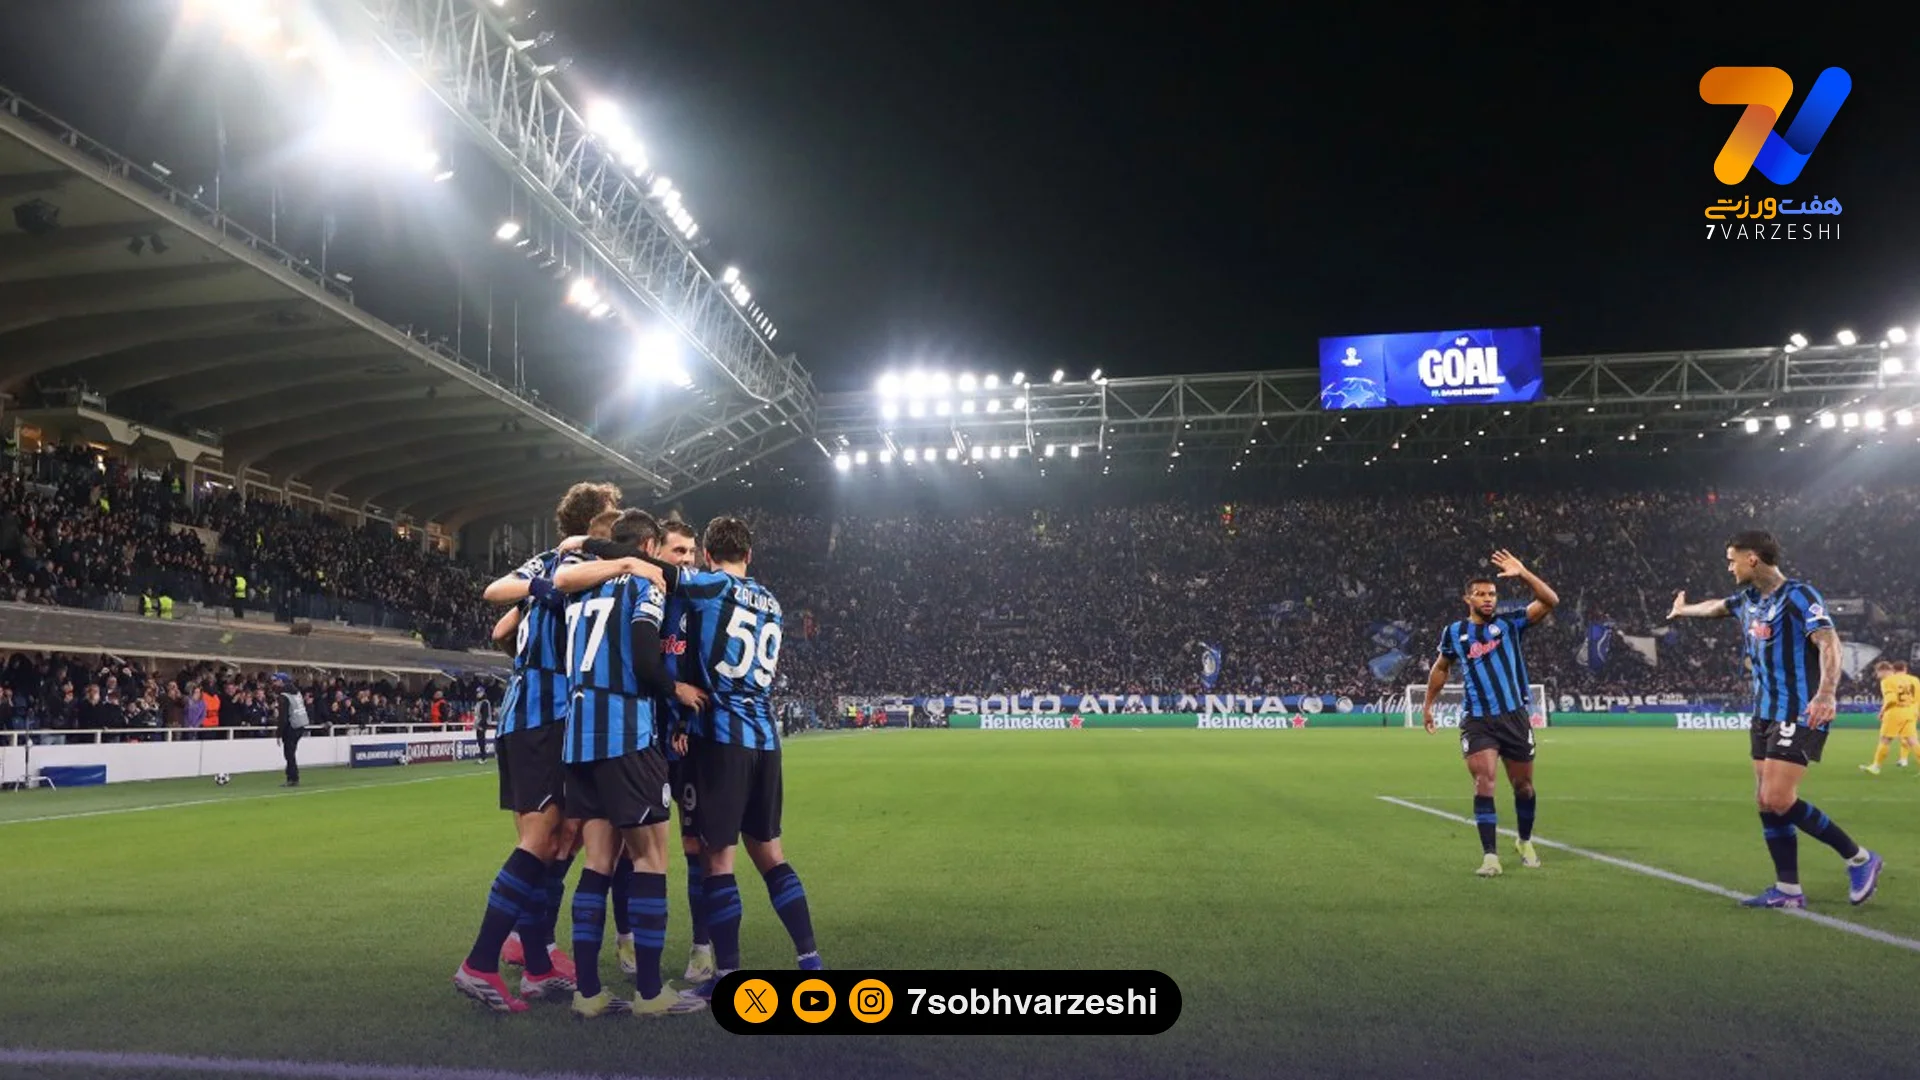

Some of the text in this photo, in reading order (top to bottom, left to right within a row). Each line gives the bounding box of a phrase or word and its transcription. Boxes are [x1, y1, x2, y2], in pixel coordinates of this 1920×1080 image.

[1418, 346, 1506, 388] GOAL
[565, 597, 615, 678] 77
[714, 605, 782, 688] 59
[953, 695, 1061, 715] SOLO
[980, 713, 1066, 729] Heineken
[1197, 713, 1288, 729] Heineken
[1675, 712, 1752, 730] Heinek
